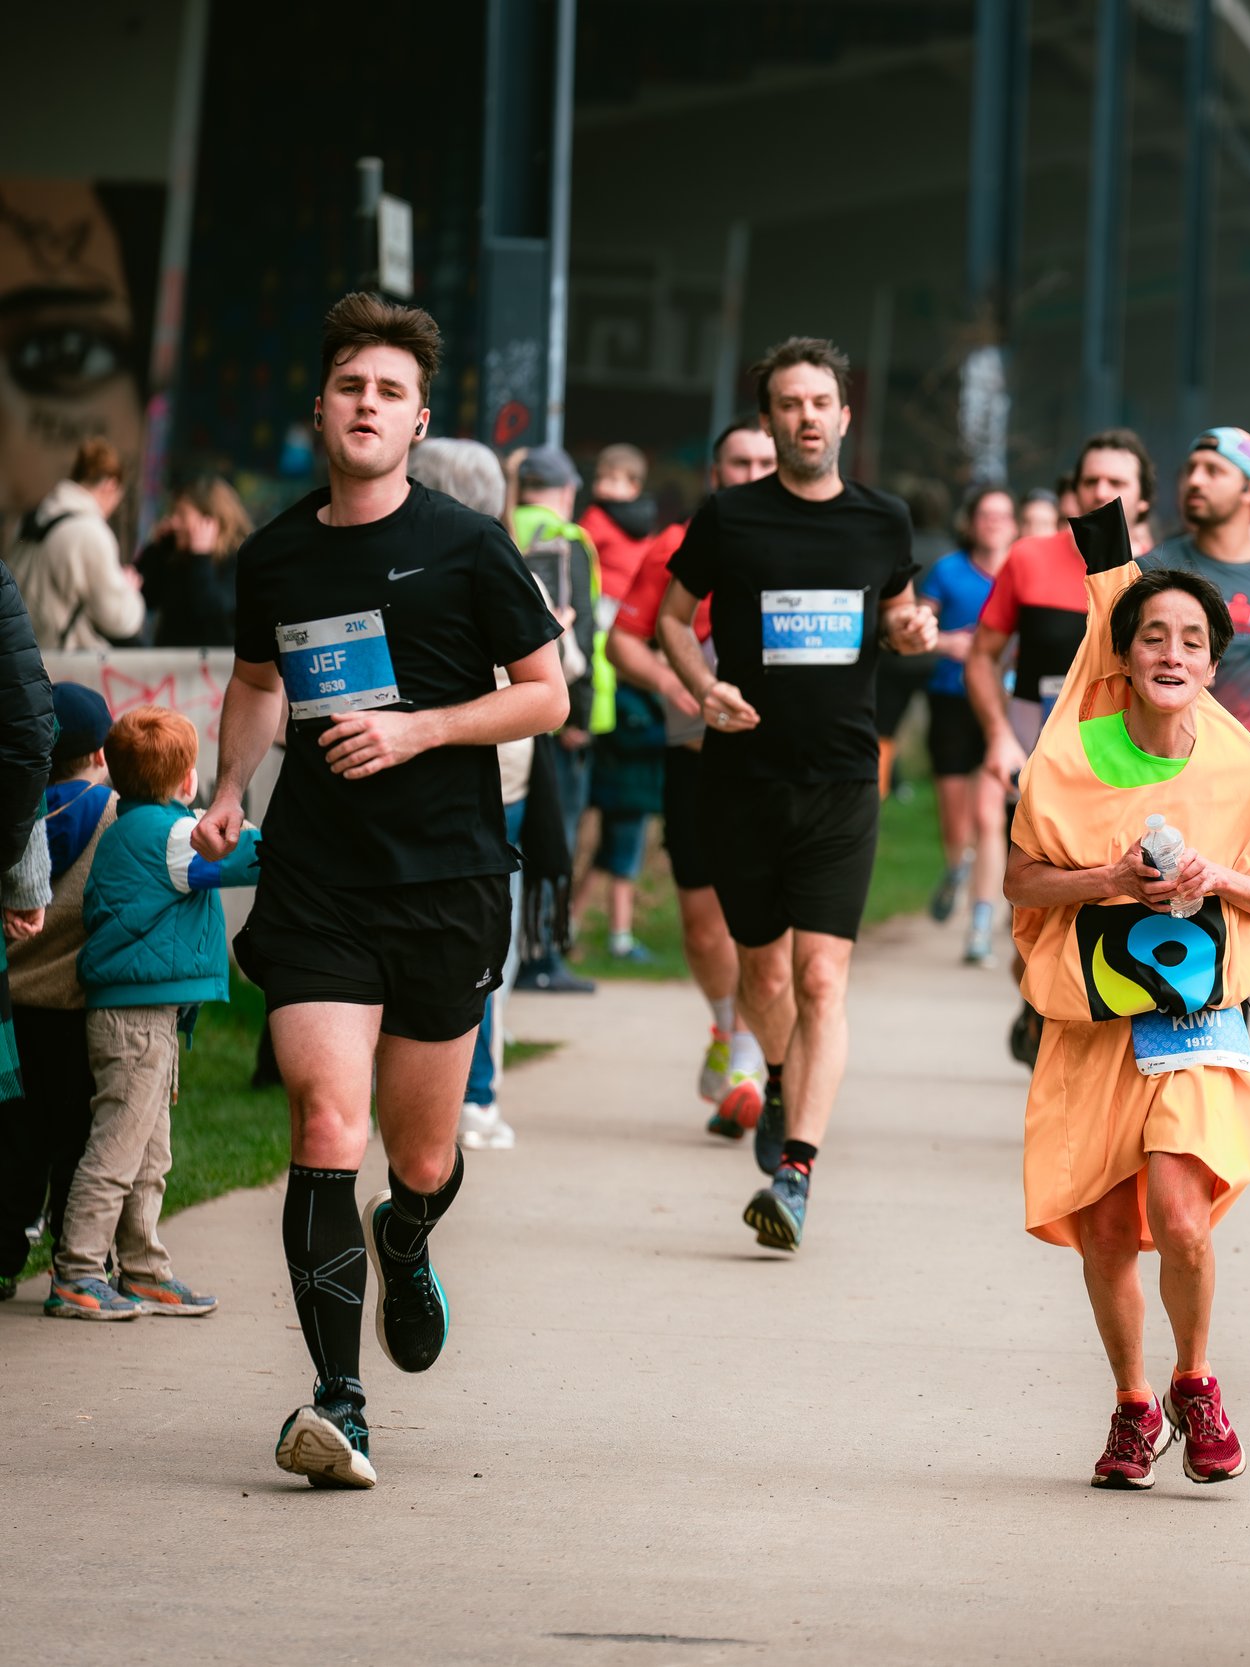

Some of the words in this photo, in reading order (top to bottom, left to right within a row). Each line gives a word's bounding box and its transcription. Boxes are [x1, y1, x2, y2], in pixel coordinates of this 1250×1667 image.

[345, 620, 369, 633] 21K
[772, 614, 852, 633] WOUTER
[309, 649, 347, 675] JEF
[319, 678, 347, 694] 3530
[1171, 1010, 1222, 1032] KIWI
[1185, 1035, 1214, 1048] 1912
